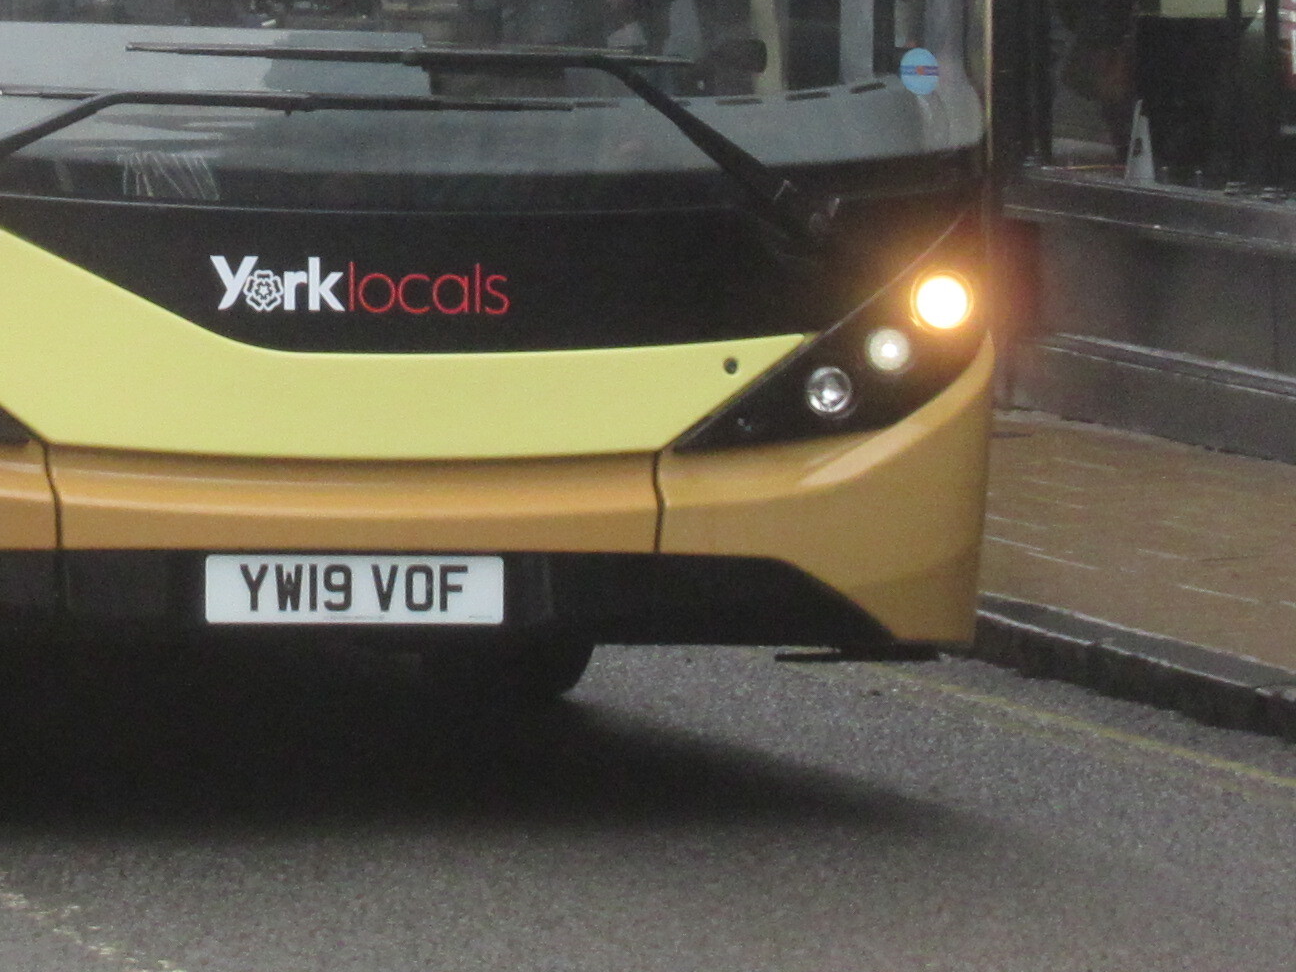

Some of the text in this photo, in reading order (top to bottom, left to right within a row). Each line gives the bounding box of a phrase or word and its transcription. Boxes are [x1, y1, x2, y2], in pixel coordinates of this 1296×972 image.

[210, 255, 510, 315] York locals
[240, 563, 468, 613] YW19 VOF
